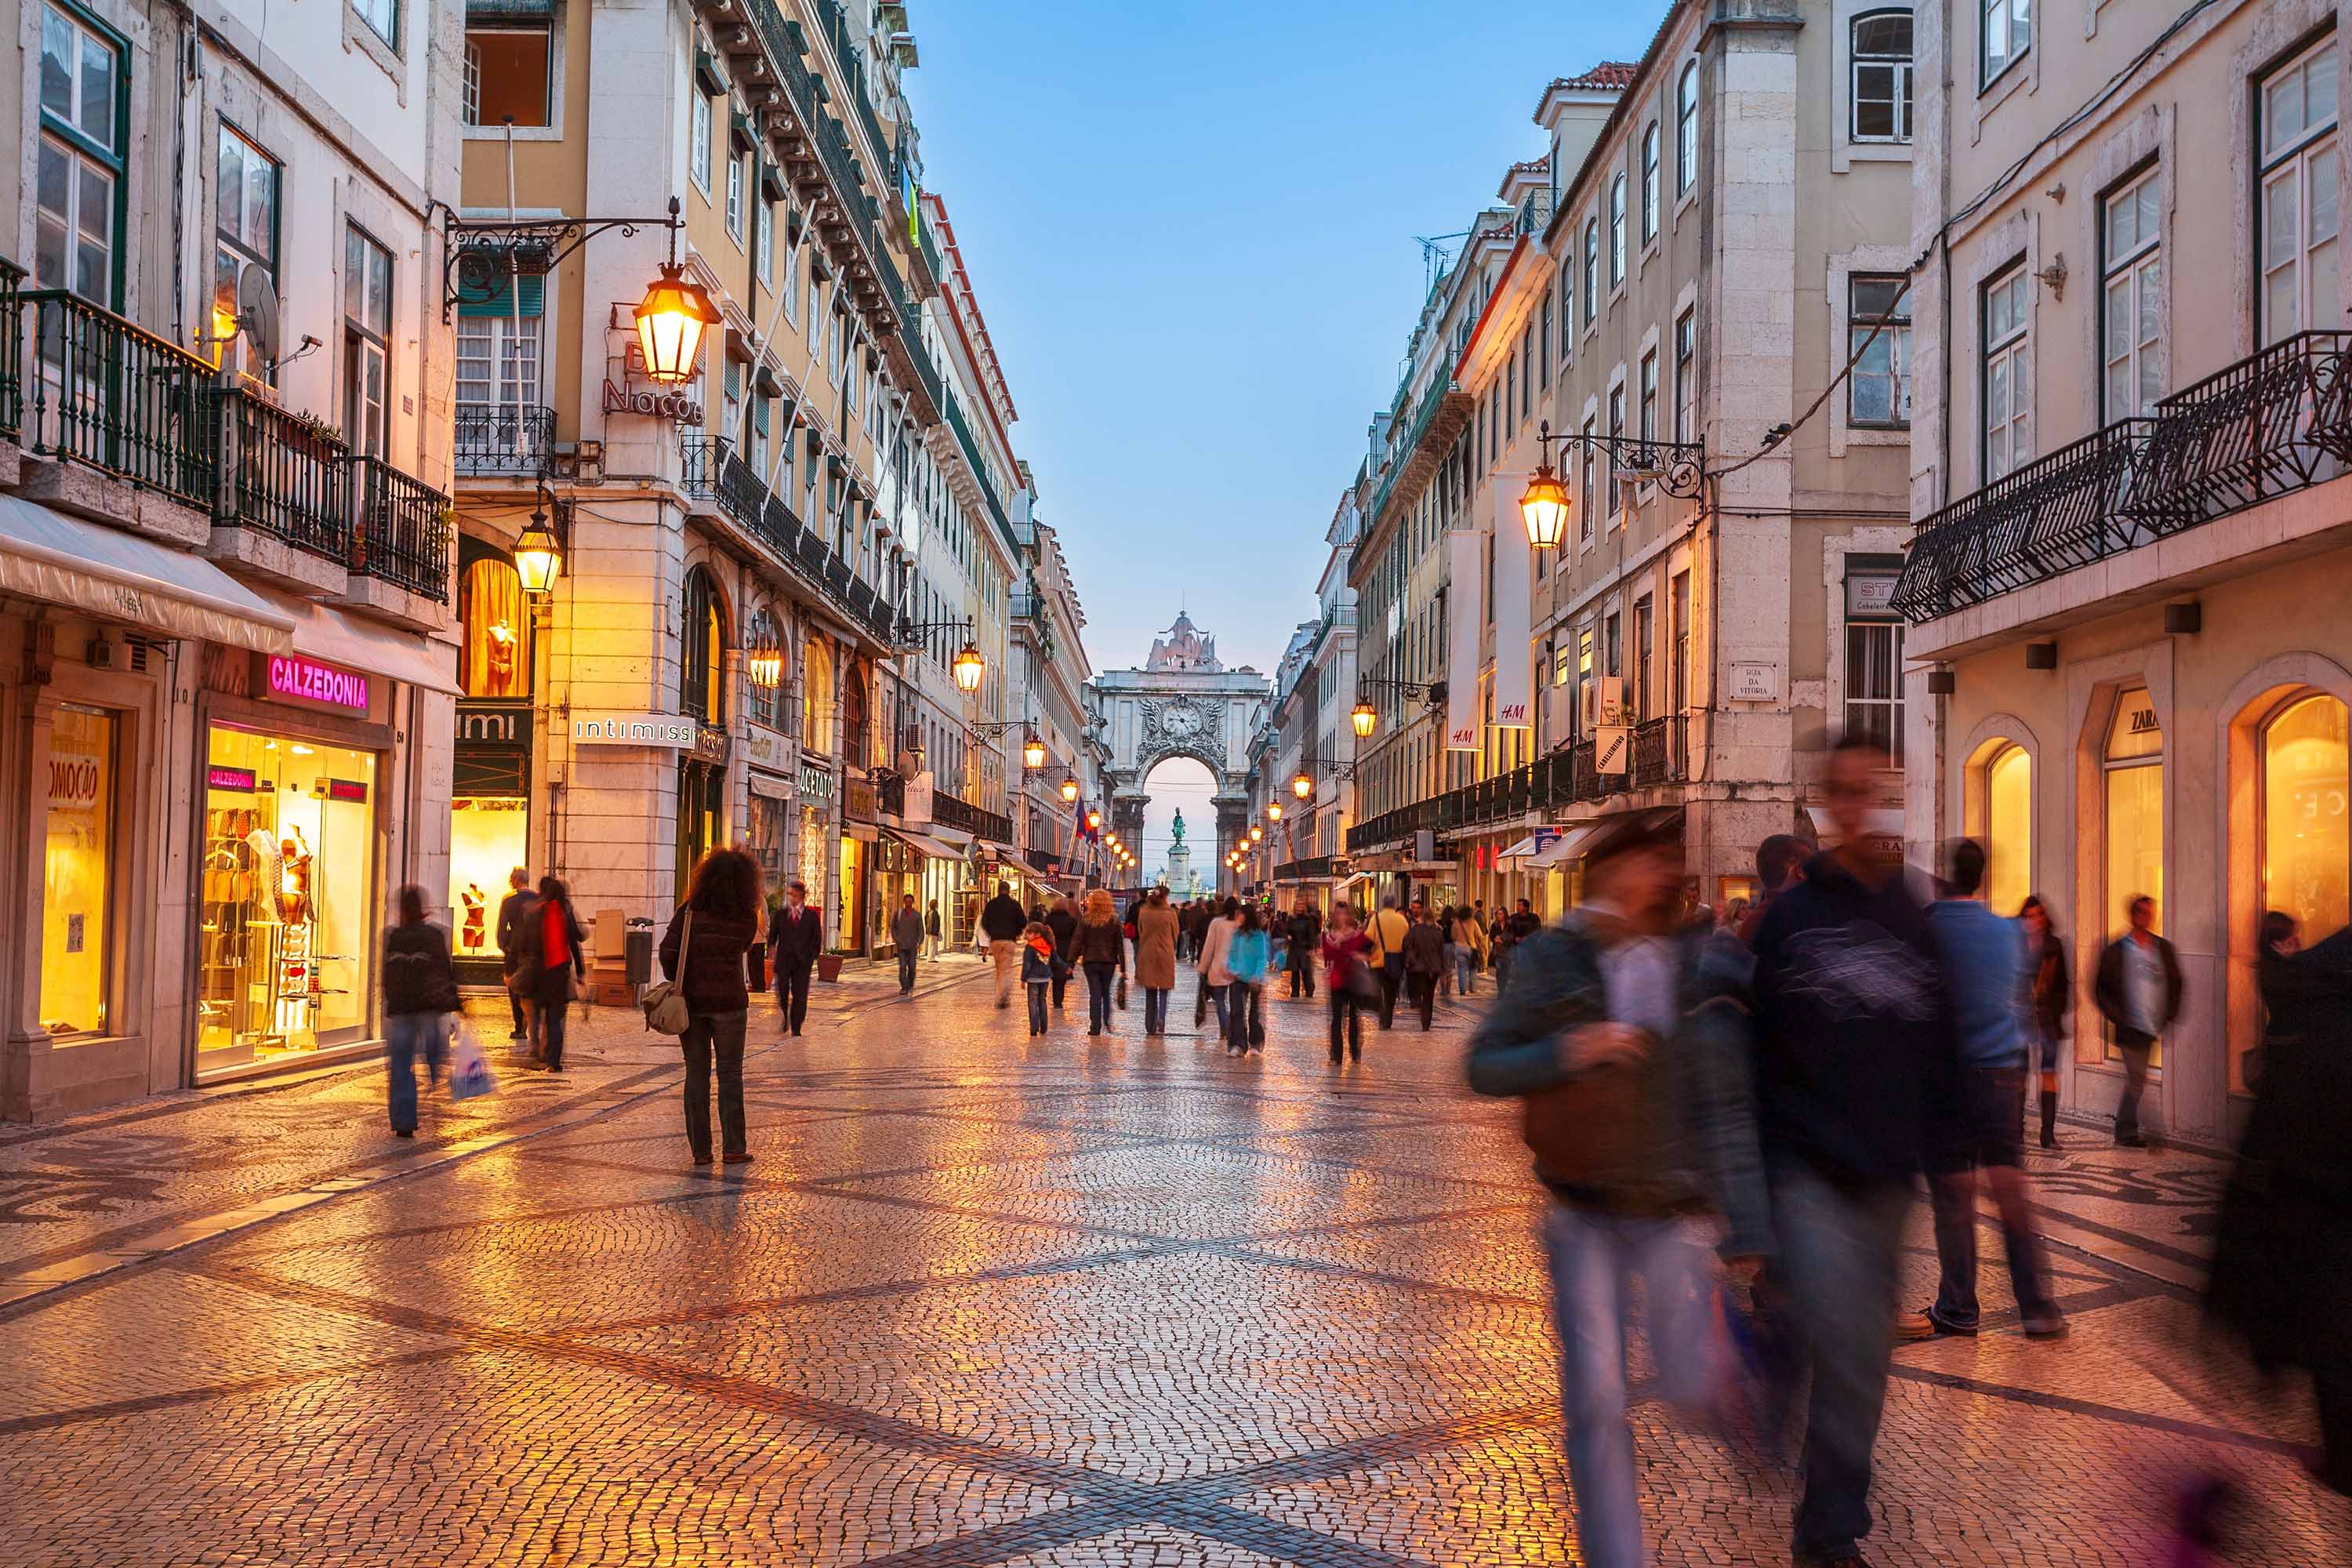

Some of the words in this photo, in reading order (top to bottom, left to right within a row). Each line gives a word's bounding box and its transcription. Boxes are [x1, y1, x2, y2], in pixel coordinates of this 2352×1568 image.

[271, 658, 367, 710] CALZEDONIA
[575, 719, 695, 744] intimissi
[2132, 709, 2159, 730] ZARA
[1598, 735, 1625, 770] CABELEIREIRO
[800, 767, 833, 799] ACETATO
